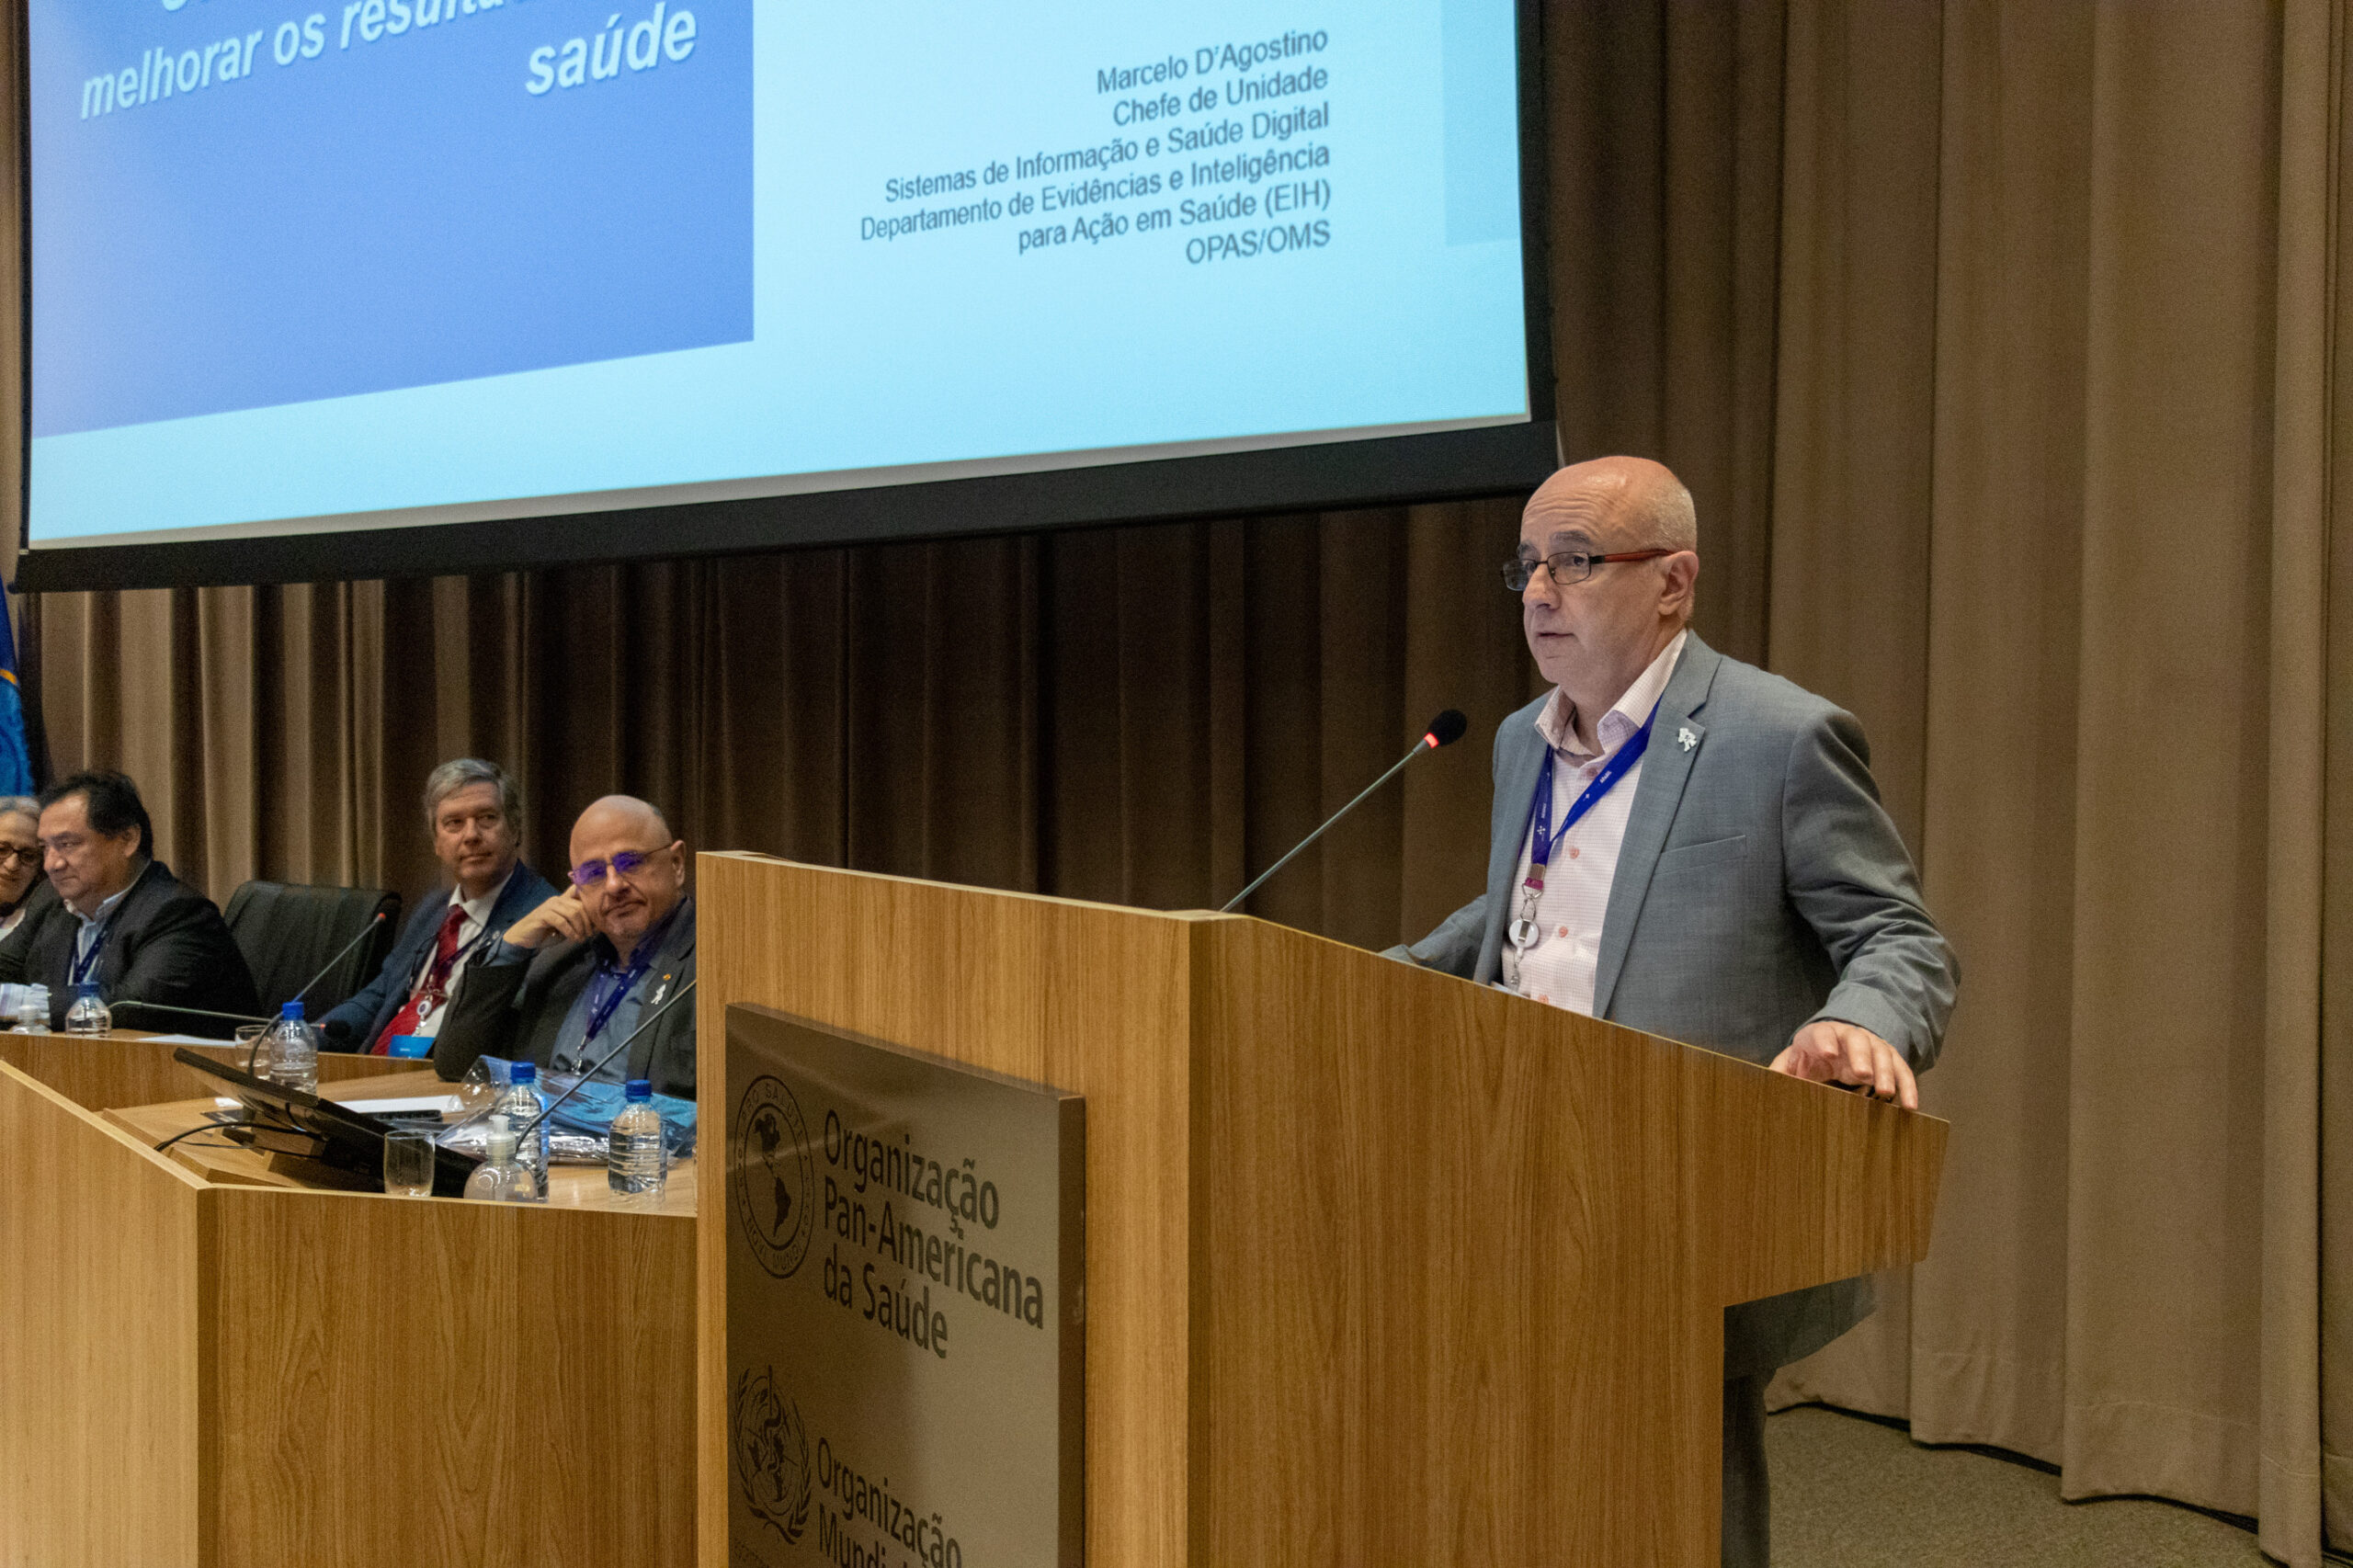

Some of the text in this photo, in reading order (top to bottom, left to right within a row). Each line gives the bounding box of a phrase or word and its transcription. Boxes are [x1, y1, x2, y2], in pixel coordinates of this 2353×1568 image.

[81, 30, 263, 119] melhorar
[274, 14, 326, 65] os
[525, 2, 697, 95] saúde
[1097, 29, 1328, 94] Marcelo D'Agostino
[1113, 65, 1328, 126] Chefe de Unidade
[860, 142, 1330, 241] Departamento de Evidências e Inteligência
[885, 101, 1329, 202] Sistemas de Informação e Saúde Digital
[1018, 178, 1331, 256] para Ação em Saúde (EIH)
[1186, 220, 1331, 264] OPAS/OMS
[825, 1109, 999, 1233] Organização
[824, 1176, 1044, 1329] Pan-Americana
[824, 1244, 948, 1359] da Saúde
[817, 1437, 962, 1568] Organização
